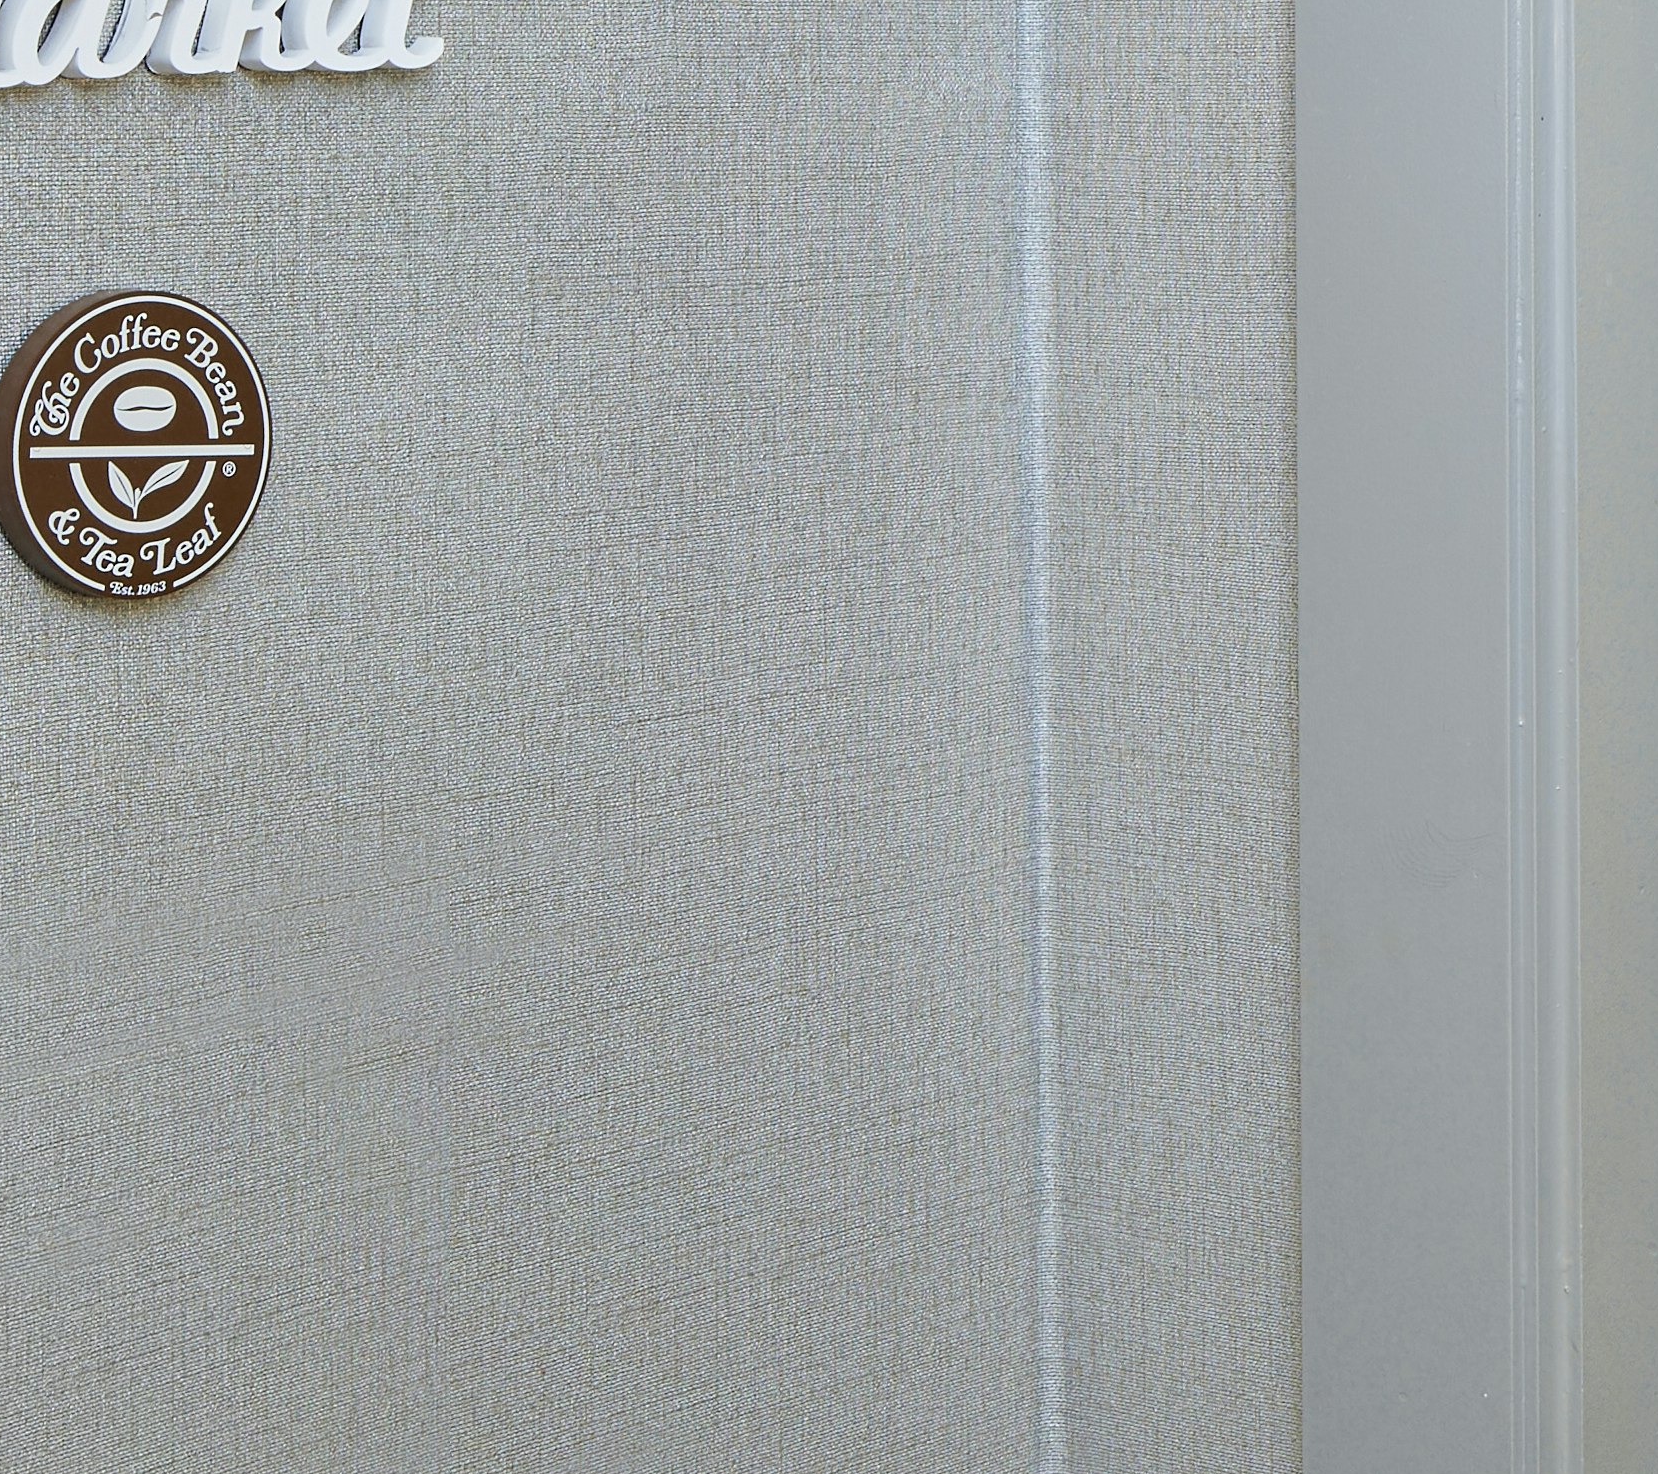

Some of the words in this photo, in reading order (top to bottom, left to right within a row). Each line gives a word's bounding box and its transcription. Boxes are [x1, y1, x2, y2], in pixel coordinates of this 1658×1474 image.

[29, 372, 80, 437] The
[74, 313, 181, 374] Coffee
[184, 327, 244, 436] Bean
[48, 507, 80, 545] &
[79, 527, 134, 577] Tea
[140, 502, 221, 576] Leaf
[110, 581, 134, 596] Est.
[137, 581, 166, 595] 1963
